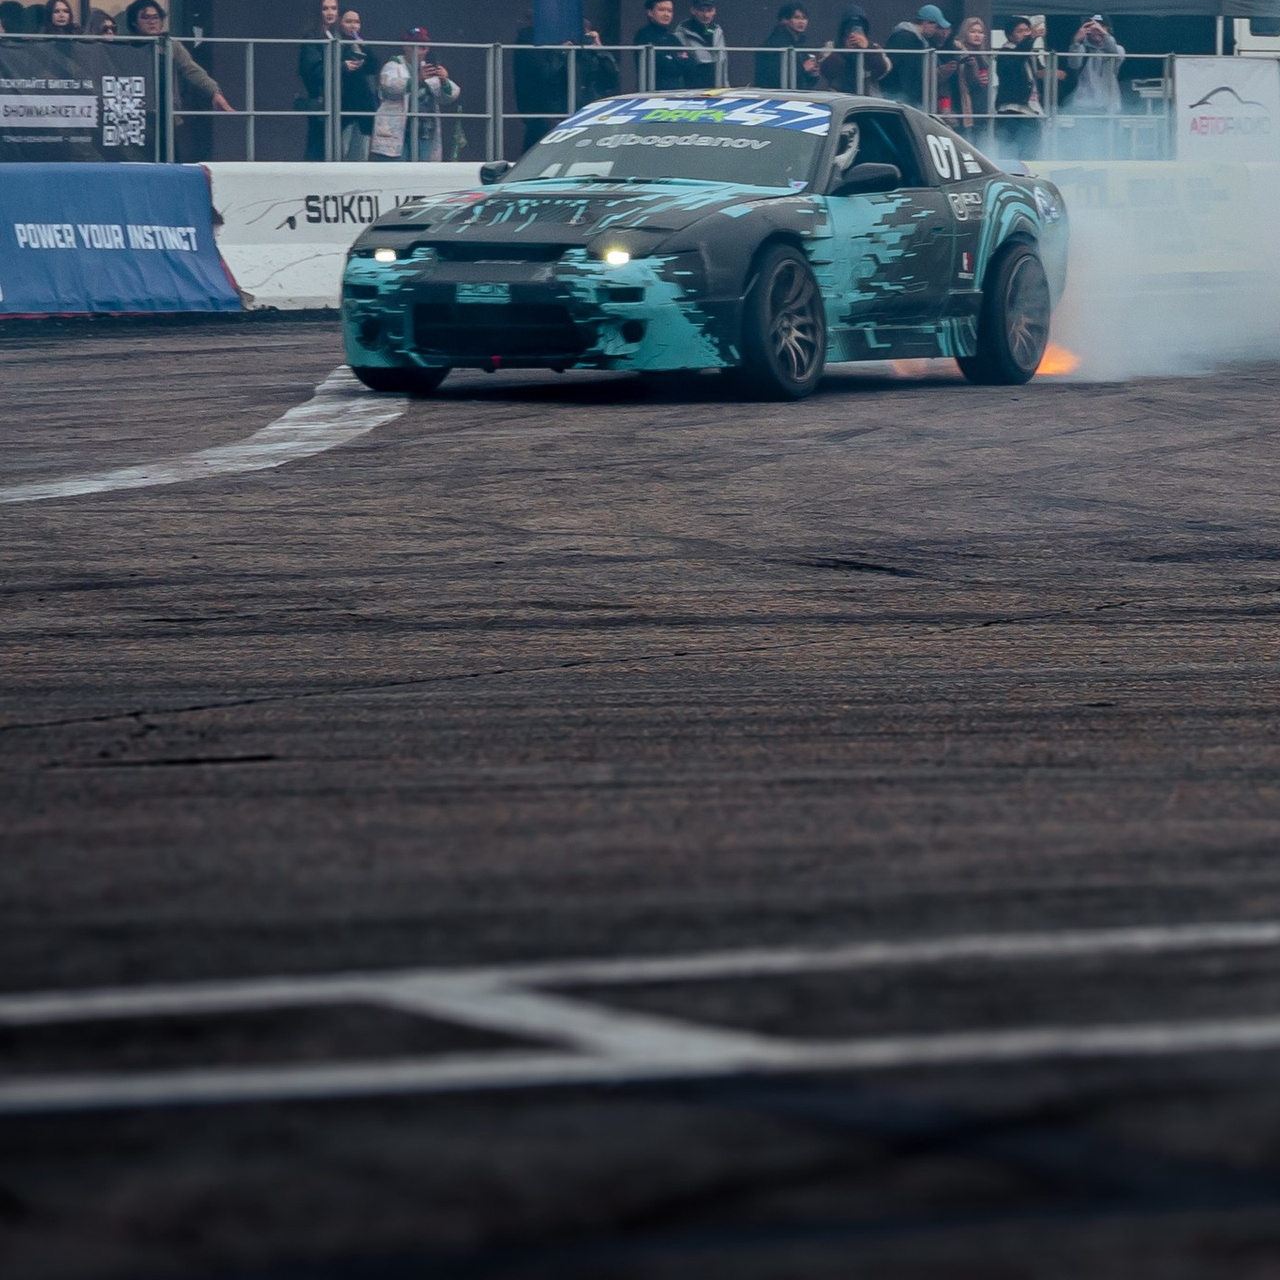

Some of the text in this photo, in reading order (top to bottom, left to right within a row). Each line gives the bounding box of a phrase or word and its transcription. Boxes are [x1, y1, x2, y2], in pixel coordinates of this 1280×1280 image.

[48, 79, 81, 89] БИЛЕТЫ
[82, 80, 94, 89] НА
[3, 104, 92, 118] SHOWMARKET.KZ
[539, 127, 587, 144] 07
[926, 134, 961, 180] 07
[15, 224, 198, 251] POWER YOUR INSTINCT
